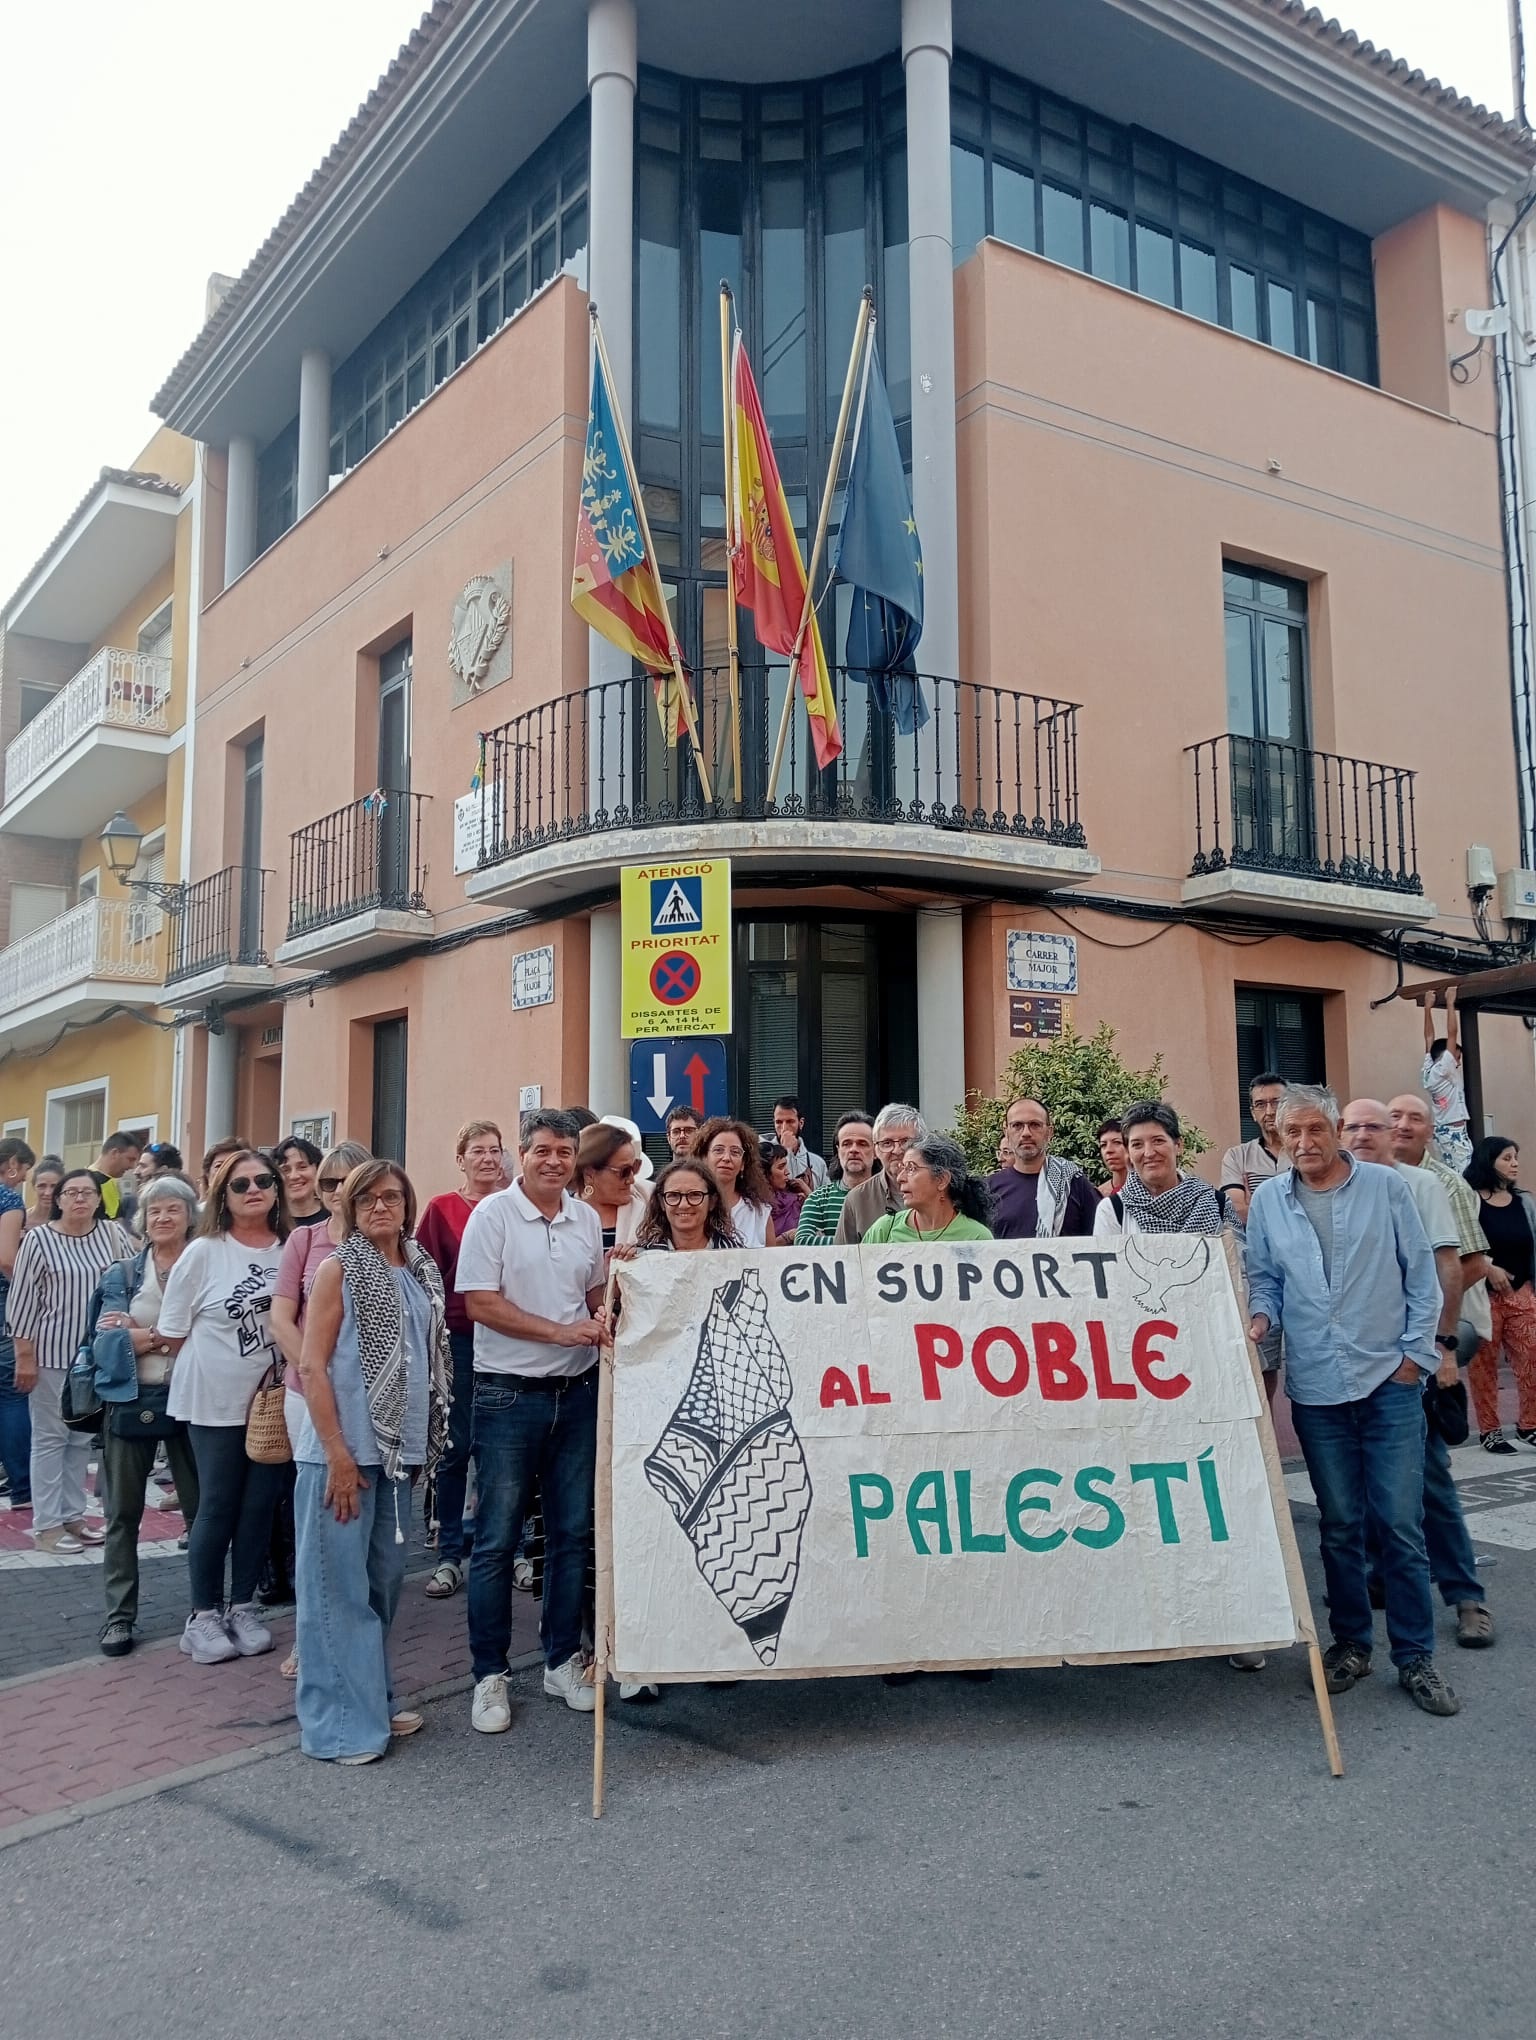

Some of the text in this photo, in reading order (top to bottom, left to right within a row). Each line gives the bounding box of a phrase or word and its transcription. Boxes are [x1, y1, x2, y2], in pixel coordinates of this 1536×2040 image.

[638, 863, 713, 880] ATENCIÓ
[631, 935, 720, 950] PRIORITAT
[1026, 949, 1059, 960] CARRER
[1028, 963, 1058, 974] MAJOR
[631, 1008, 698, 1018] DISSABTES
[636, 1023, 716, 1034] PER MERCAT
[780, 1251, 1118, 1305] EN SUPORT
[820, 1320, 1192, 1408] AL POBLE
[848, 1446, 1230, 1558] PALESTÍ
